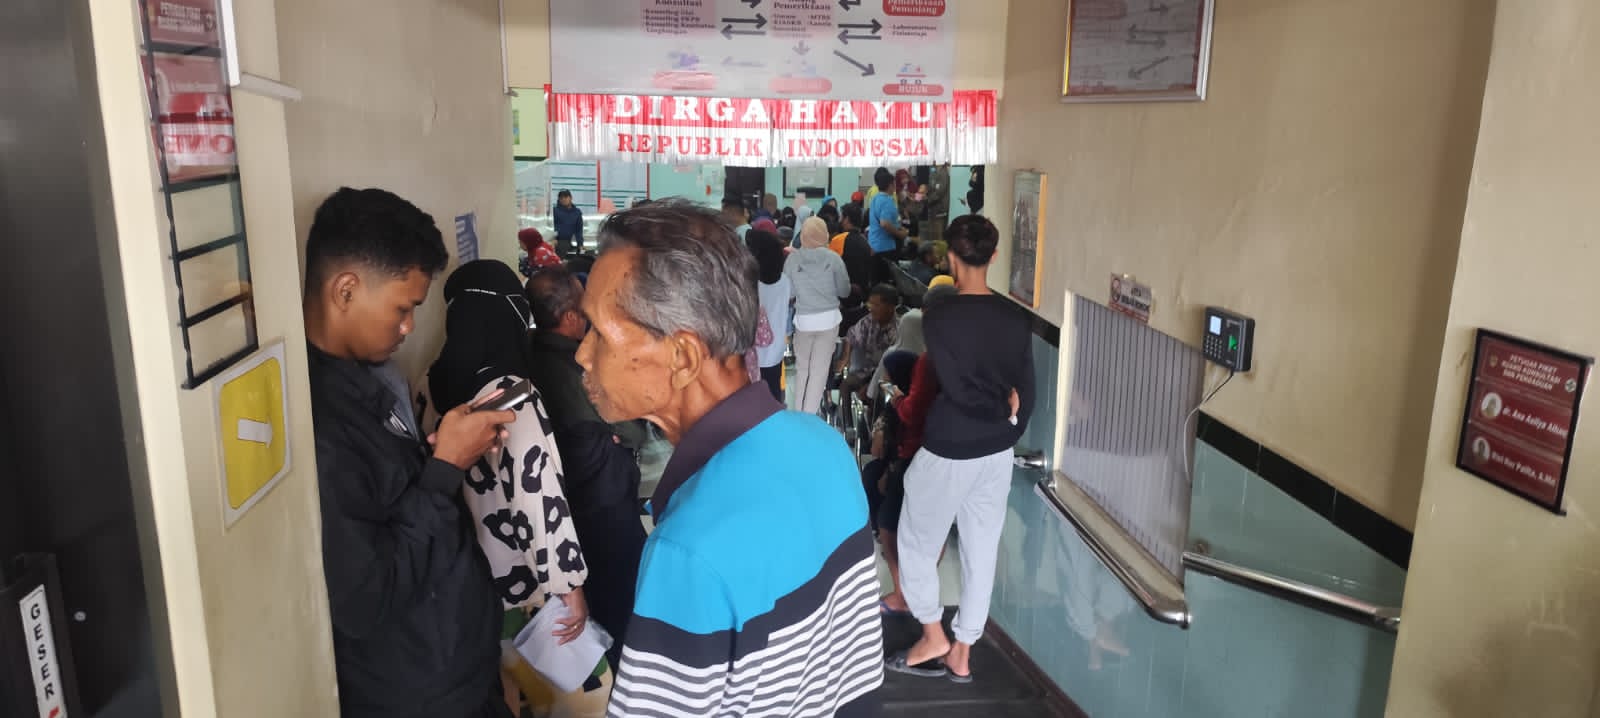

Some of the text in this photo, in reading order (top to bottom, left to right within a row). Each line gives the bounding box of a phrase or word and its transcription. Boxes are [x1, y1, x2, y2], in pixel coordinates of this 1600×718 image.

[773, 2, 832, 11] Pemeriksaan
[617, 133, 929, 158] REPUBLIK INDONESIA
[1501, 361, 1561, 384] RUANG KONSULTASI
[1510, 354, 1557, 373] PETUGAS PIKET
[1515, 374, 1553, 391] PENGADUAN
[30, 603, 55, 700] GESER
